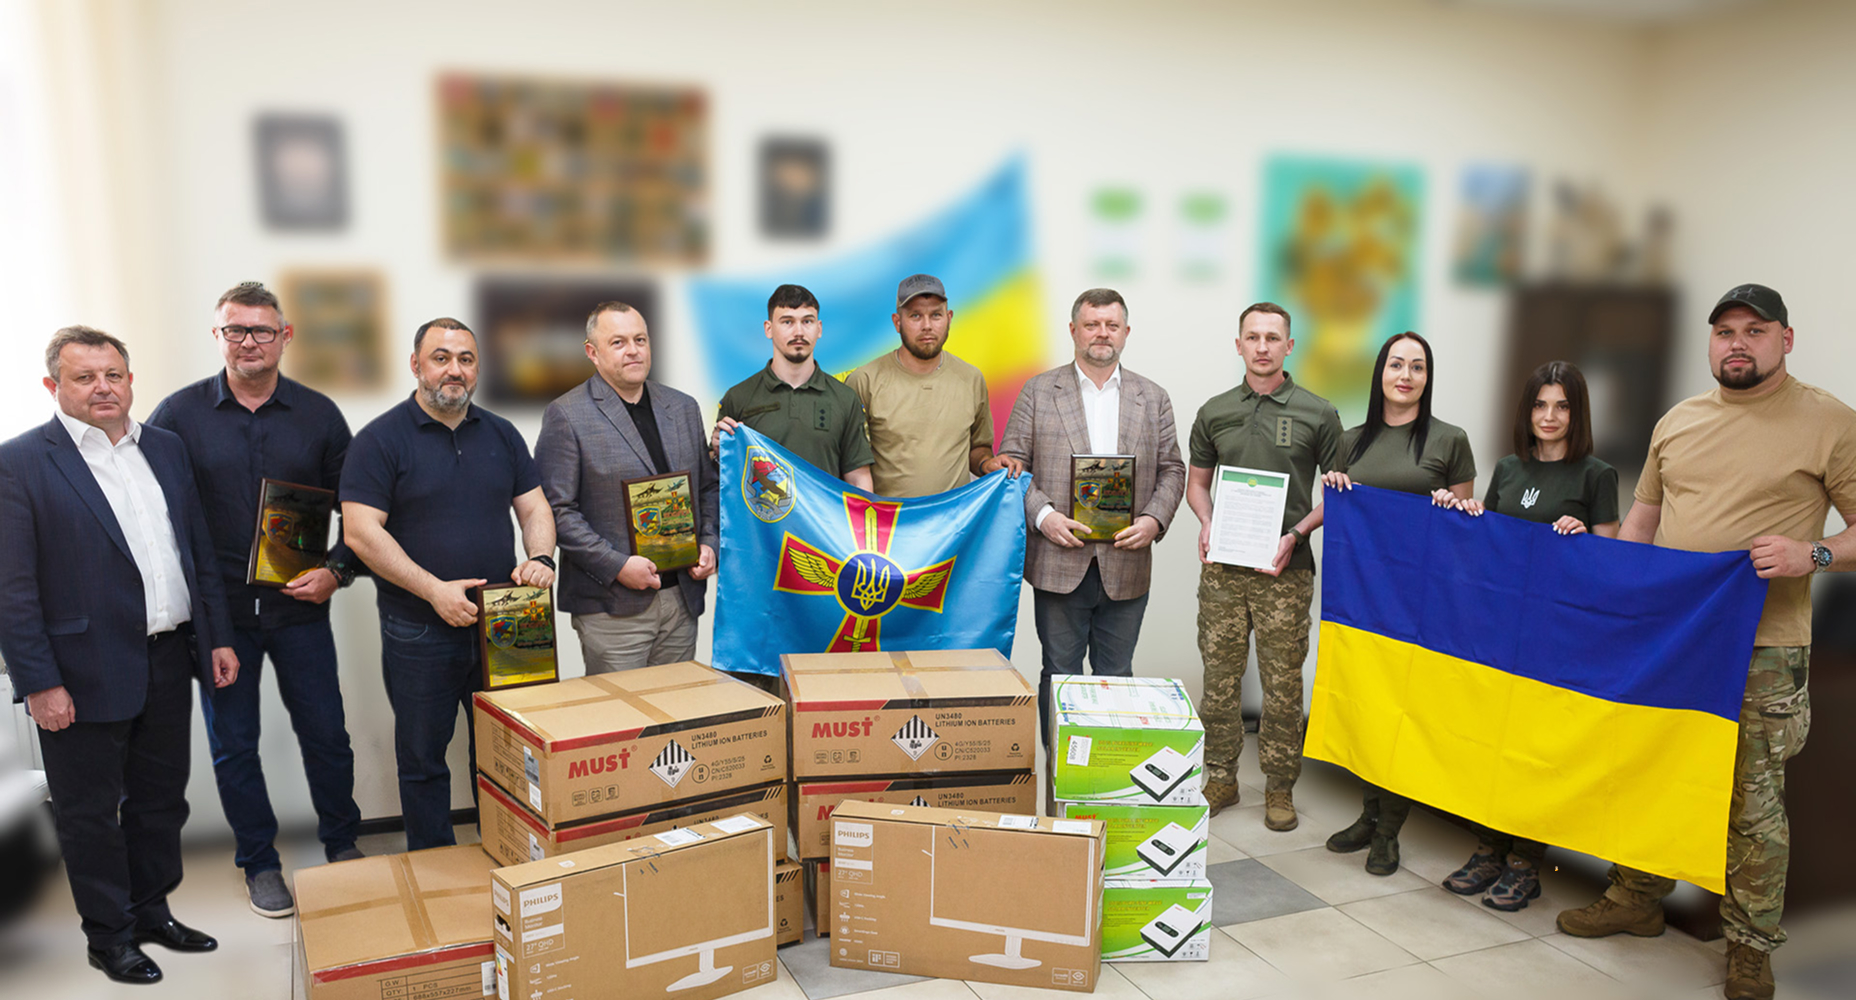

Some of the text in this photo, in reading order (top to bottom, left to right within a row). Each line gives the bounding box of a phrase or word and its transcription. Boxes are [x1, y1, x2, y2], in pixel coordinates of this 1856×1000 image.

[935, 712, 962, 720] UN3480
[811, 716, 873, 738] MUST
[935, 718, 1016, 728] LITHIUM ION BATTERIES
[691, 731, 718, 742] UN3480
[691, 730, 768, 750] LITHIUM ION BATTERIES
[568, 748, 631, 779] MUST
[937, 792, 965, 800] UN3480
[937, 800, 965, 808] LITHIUM
[980, 796, 1017, 805] BATTERIES
[837, 830, 870, 840] PHILIPS
[523, 892, 559, 908] PHILIPS
[538, 939, 554, 949] QHD
